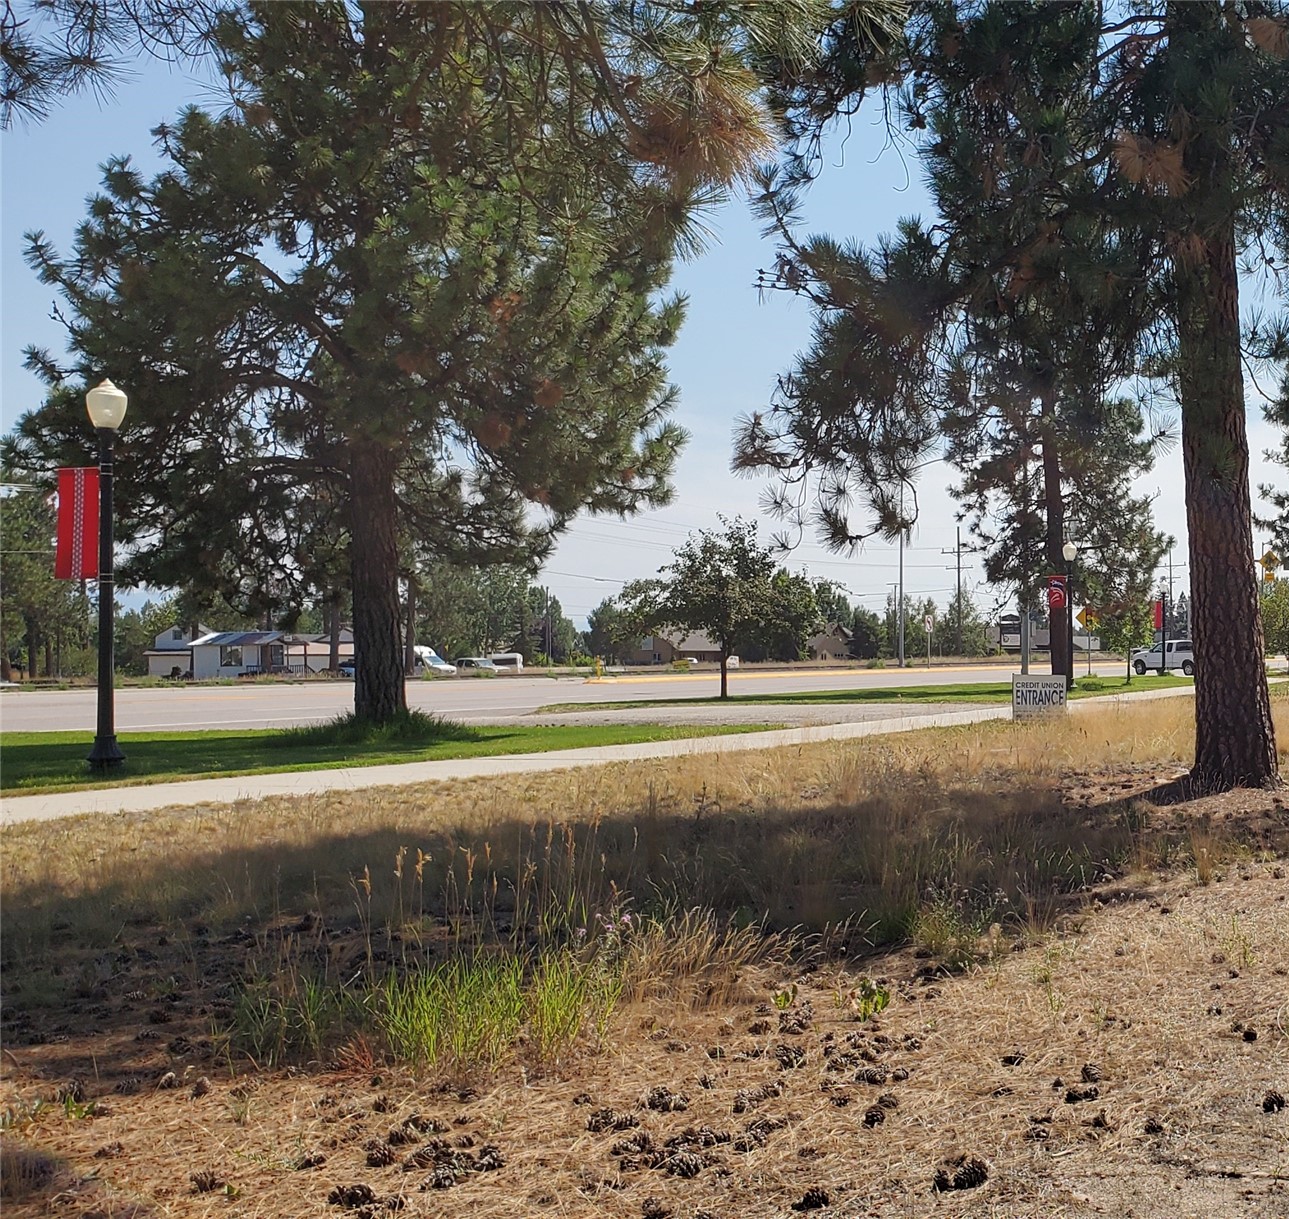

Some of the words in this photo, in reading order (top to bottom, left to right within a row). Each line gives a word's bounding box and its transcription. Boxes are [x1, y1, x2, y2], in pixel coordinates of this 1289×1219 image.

[1015, 681, 1040, 689] CREDIT
[1041, 681, 1064, 689] UNION
[1016, 689, 1064, 705] ENTRANCE
